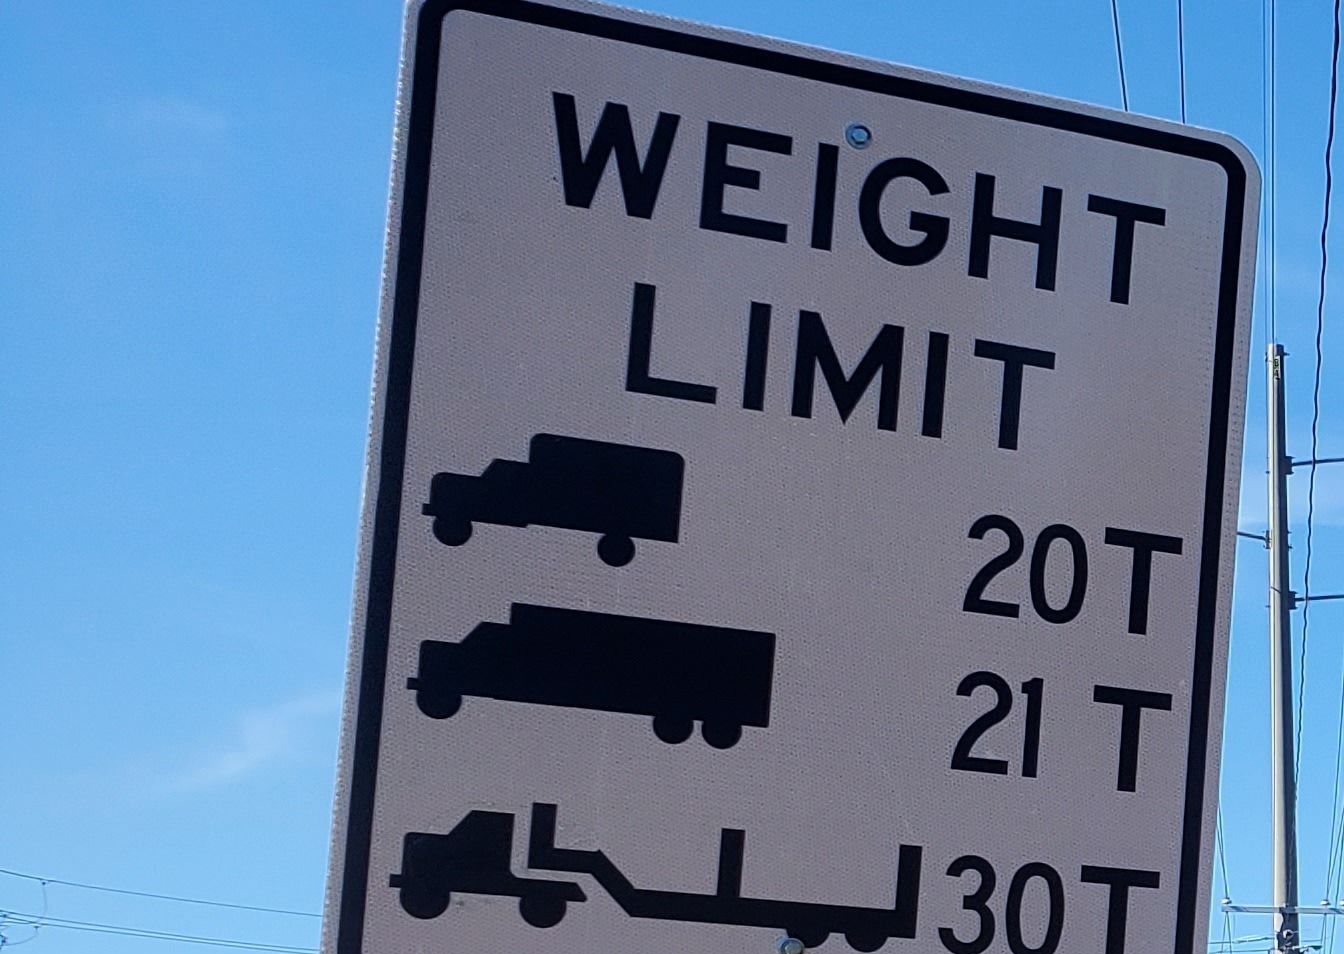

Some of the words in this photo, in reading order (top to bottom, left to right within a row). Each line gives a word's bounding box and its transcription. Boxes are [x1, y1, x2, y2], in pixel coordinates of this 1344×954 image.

[552, 91, 1167, 306] WEIGHT
[624, 281, 1056, 451] LIMIT
[950, 670, 1045, 779] 21
[1092, 684, 1173, 793] T
